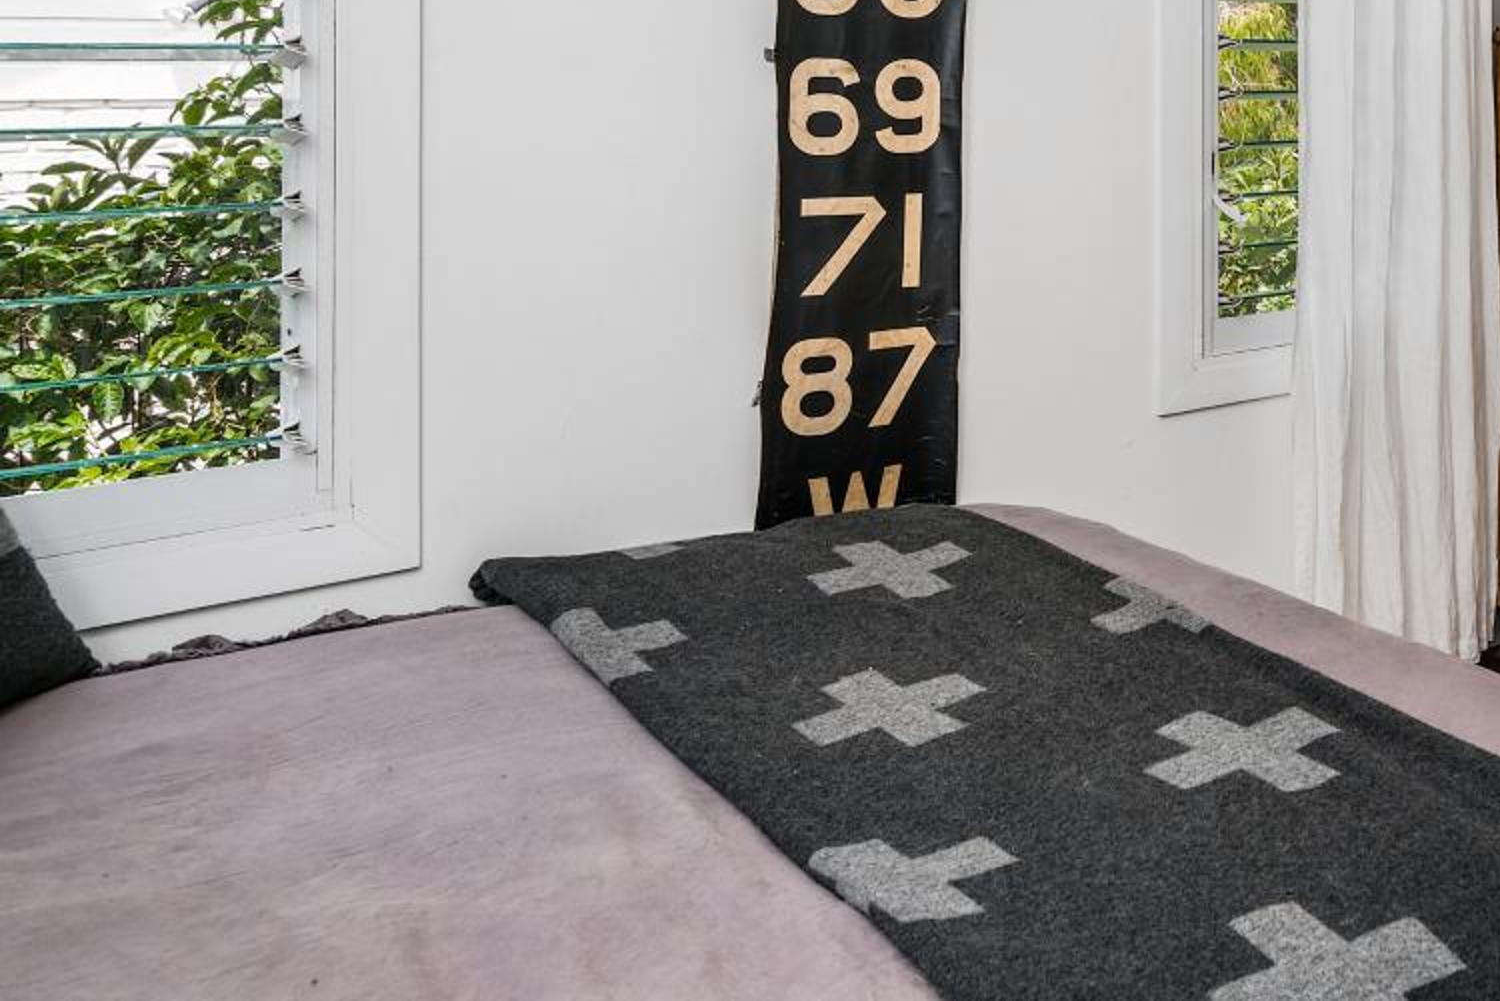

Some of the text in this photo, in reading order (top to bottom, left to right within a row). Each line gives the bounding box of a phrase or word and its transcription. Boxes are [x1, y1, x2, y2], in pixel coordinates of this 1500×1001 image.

[788, 57, 941, 156] 69
[800, 192, 923, 297] 71
[781, 326, 937, 436] 87
